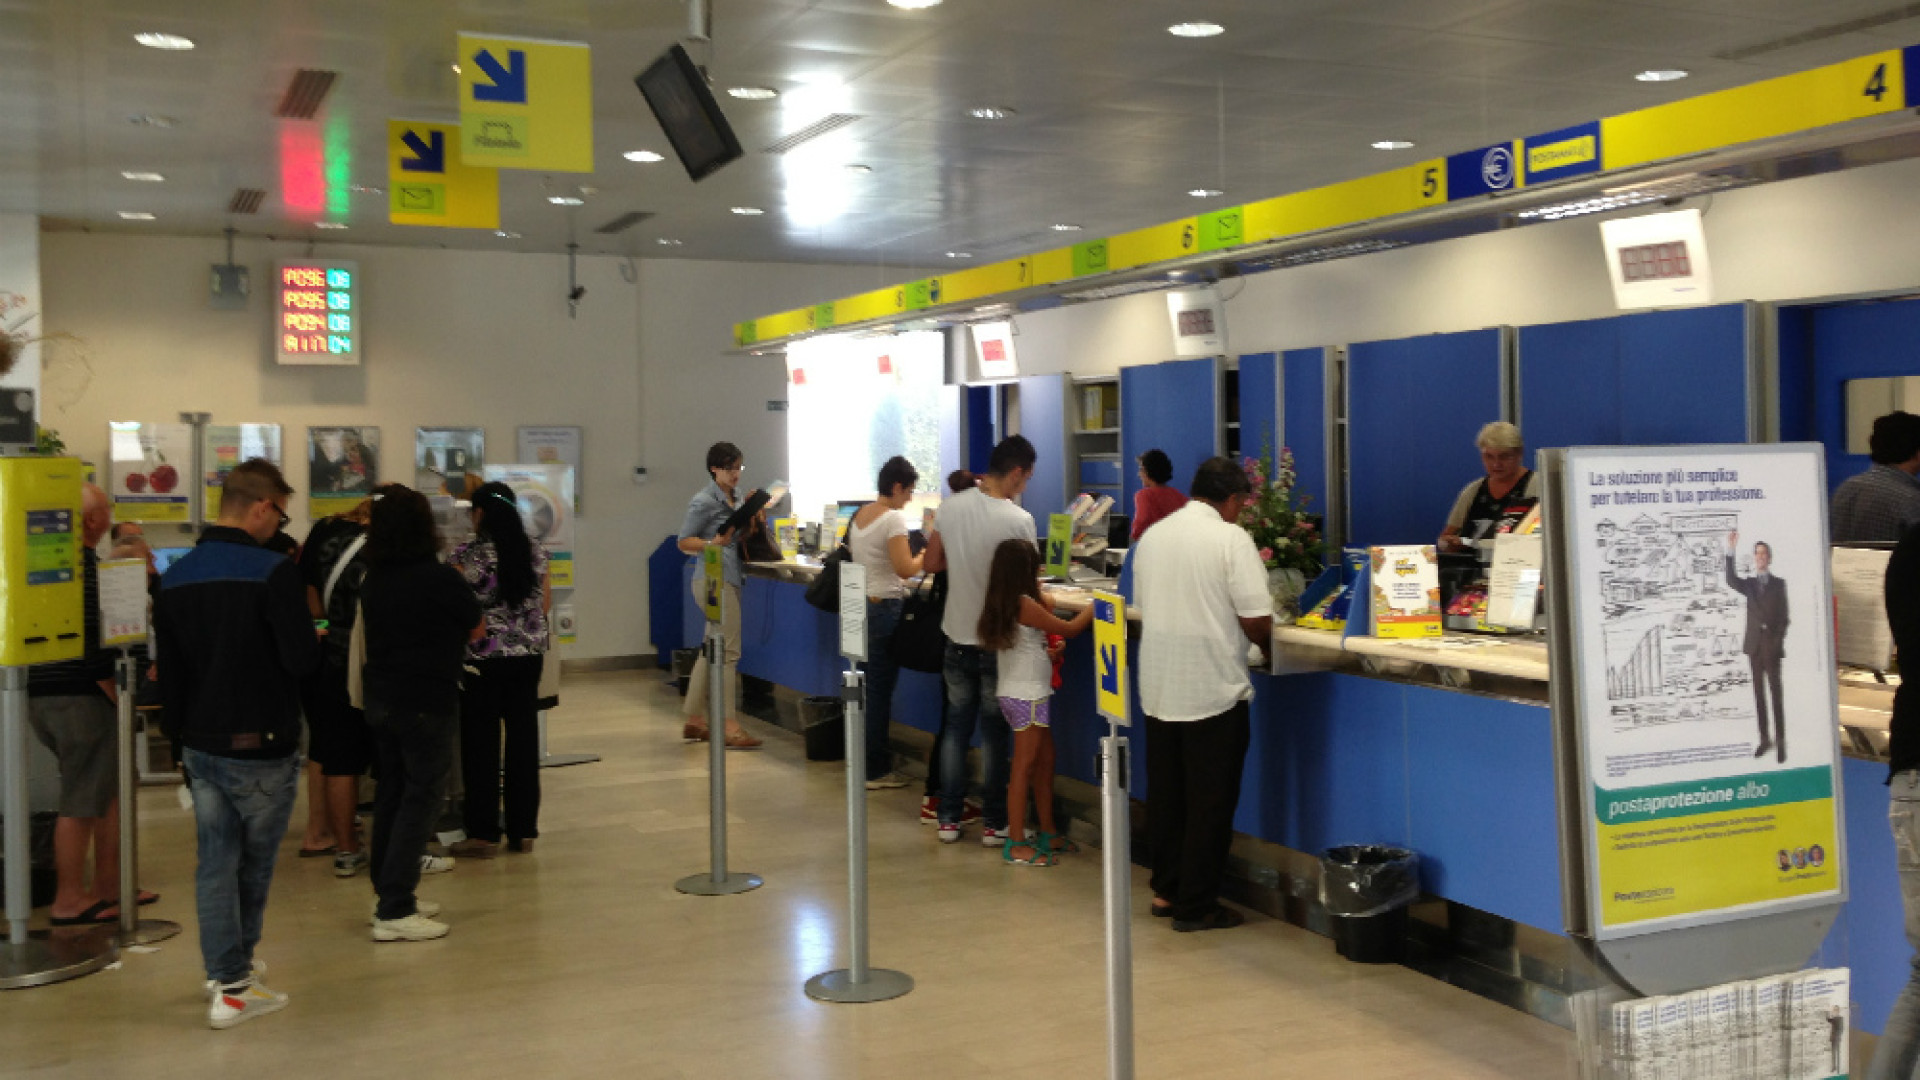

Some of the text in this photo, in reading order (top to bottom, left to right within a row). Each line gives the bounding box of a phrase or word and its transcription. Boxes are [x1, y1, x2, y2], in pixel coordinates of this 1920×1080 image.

[1862, 62, 1889, 103] 4
[1422, 167, 1439, 198] 5
[1181, 223, 1194, 250] 6
[1017, 260, 1027, 283] 7
[1589, 467, 1738, 487] La soluzione più semplice
[1590, 486, 1767, 508] per tutelare la tua professione.
[1608, 780, 1771, 820] postaprotezione albo
